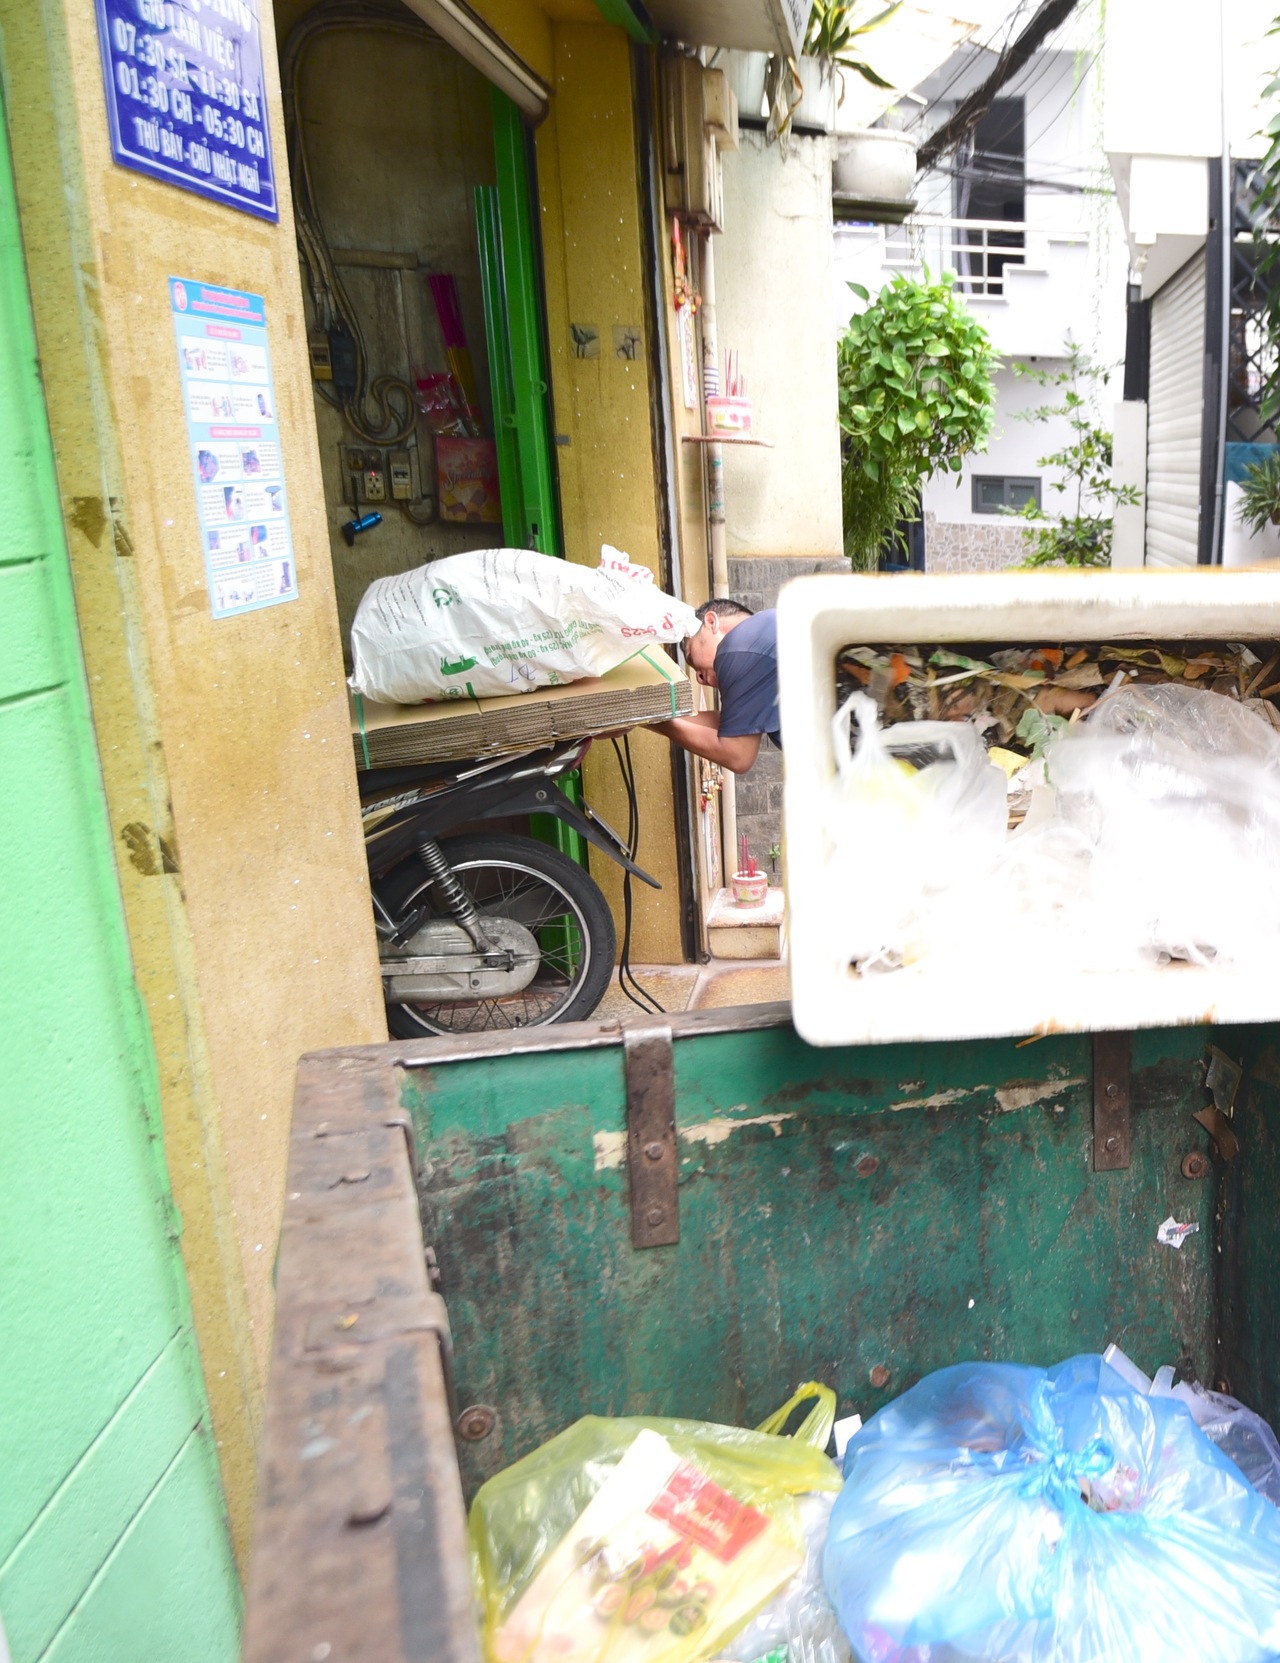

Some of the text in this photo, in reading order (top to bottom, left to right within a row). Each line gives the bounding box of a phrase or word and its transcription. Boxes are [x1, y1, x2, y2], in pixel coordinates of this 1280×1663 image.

[114, 18, 165, 71] 07:30
[168, 48, 190, 84] SA
[201, 66, 240, 110] 11:30
[242, 89, 260, 121] SA
[118, 62, 169, 113] 01:30
[171, 88, 193, 124] CH
[203, 105, 245, 148] 05:30
[246, 126, 264, 158] CH
[160, 121, 183, 162] BẢY
[211, 151, 237, 187] NHẬT
